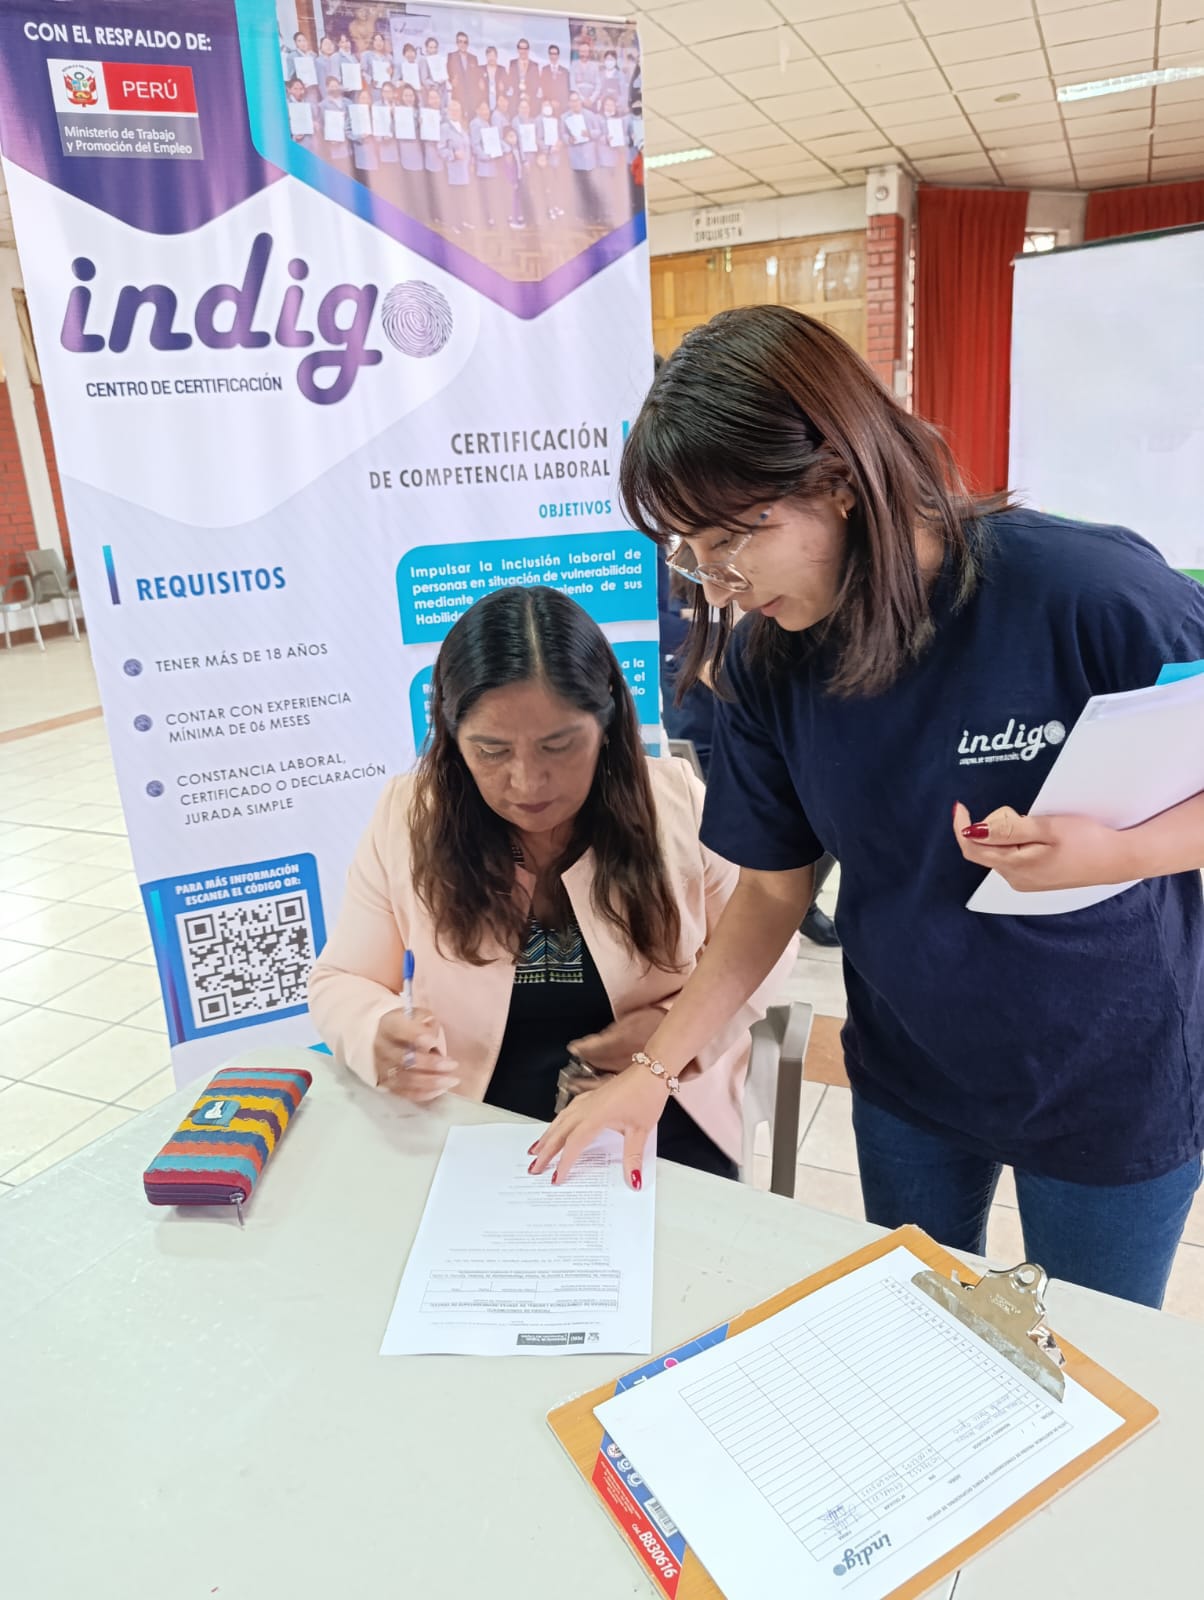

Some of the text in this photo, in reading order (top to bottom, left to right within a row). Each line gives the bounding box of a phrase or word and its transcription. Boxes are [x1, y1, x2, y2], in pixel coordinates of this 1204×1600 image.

[24, 22, 212, 51] CON EL RESPALDO DE:
[122, 78, 178, 99] PERÚ
[64, 126, 175, 142] Ministerio de Trabajo
[66, 140, 192, 155] y Promoción del Empleo
[86, 372, 283, 398] CENTRO DE CERTIFICACIÓN
[451, 422, 608, 455] CERTIFICACIÓN
[369, 459, 610, 489] DE COMPETENCIA LABORAL
[539, 500, 612, 518] OBJETIVOS
[411, 549, 641, 579] Impulsar la inclusión laboral de
[412, 576, 467, 595] personas
[470, 579, 486, 589] en
[488, 572, 541, 587] situación
[543, 570, 558, 582] de
[561, 563, 642, 580] vulnerabilidad
[136, 567, 286, 601] REQUISITOS
[414, 594, 474, 609] mediante
[601, 580, 616, 591] de
[624, 580, 643, 589] sus
[155, 643, 328, 673] TENER MÁS DE 18 AÑOS
[633, 658, 645, 668] la
[634, 671, 645, 682] el
[166, 692, 351, 726] CONTAR CON EXPERIENCIA
[169, 714, 311, 743] MÍNIMA DE 06 MESES
[177, 753, 346, 787] CONSTANCIA LABORAL,
[180, 763, 386, 806] CERTIFICADO O DECLARACIÓN
[185, 798, 293, 825] JURADA SIMPLE
[175, 864, 299, 895] PARA MÁS INFORMACIÓN
[185, 876, 301, 906] ESCANEA EL CÓDIGO QR:
[639, 1531, 678, 1579] B830616
